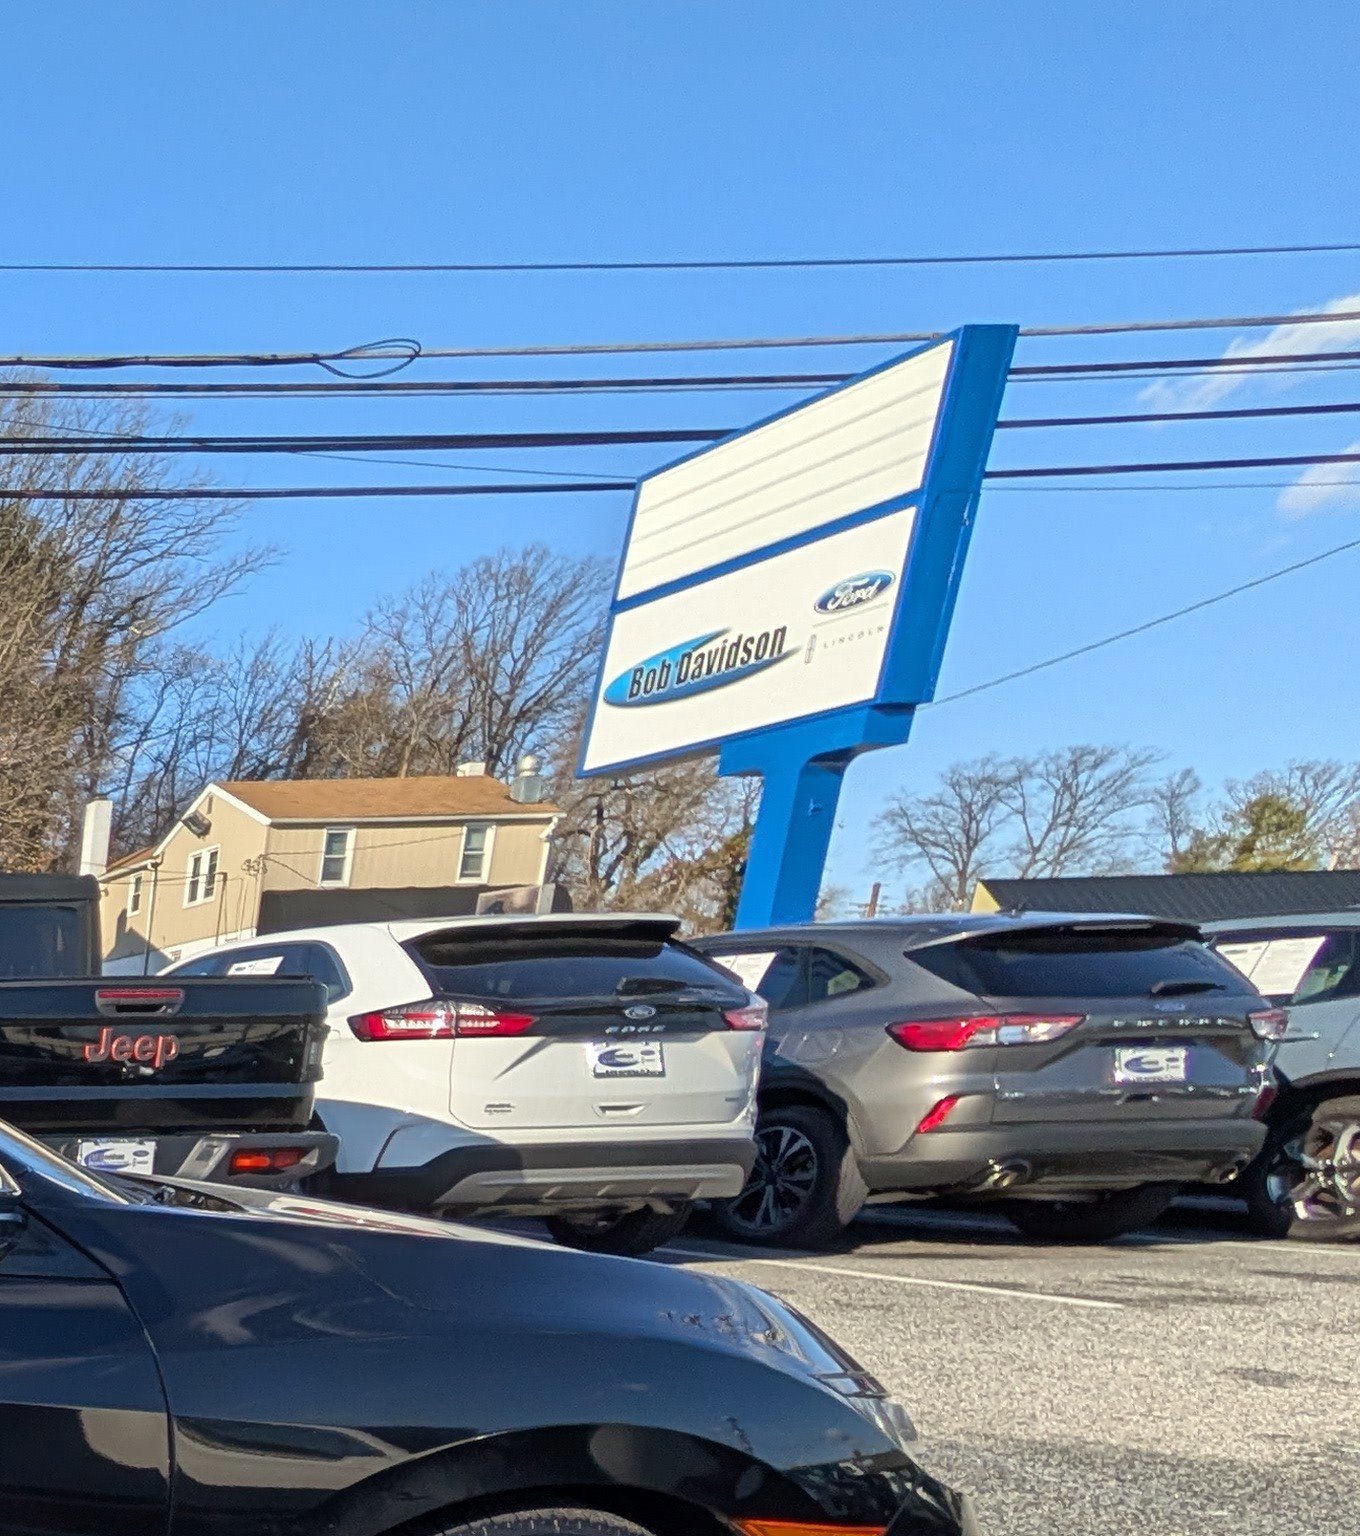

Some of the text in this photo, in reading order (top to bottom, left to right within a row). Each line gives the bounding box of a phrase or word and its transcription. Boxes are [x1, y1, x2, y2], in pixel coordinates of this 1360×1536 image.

[829, 577, 879, 610] Ford
[822, 625, 885, 650] LINCOLN
[629, 625, 788, 699] Bob Davidson
[83, 1026, 180, 1070] Jeep
